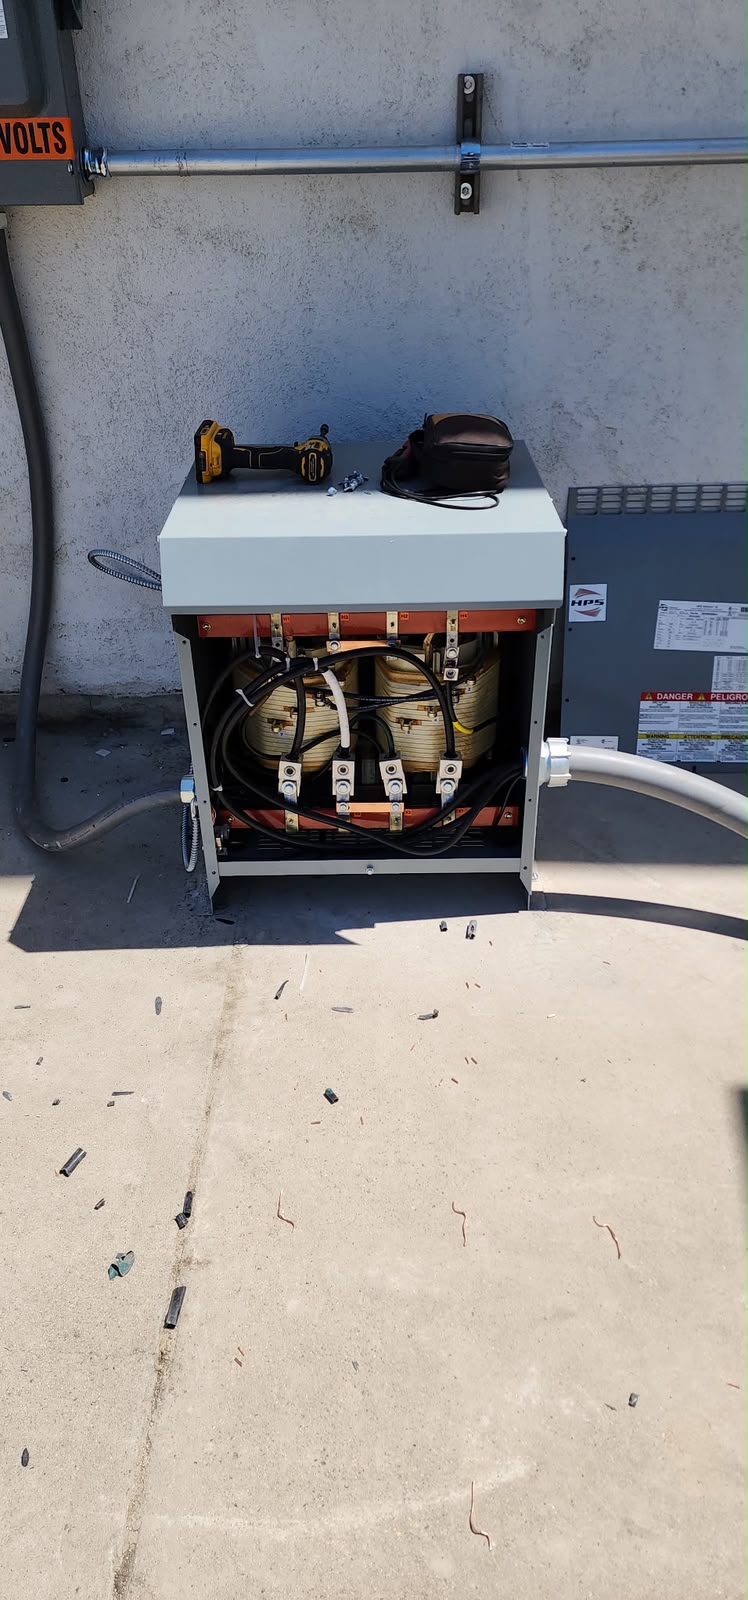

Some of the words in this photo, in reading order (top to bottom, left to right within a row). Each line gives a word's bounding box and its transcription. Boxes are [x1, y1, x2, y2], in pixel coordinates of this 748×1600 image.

[0, 121, 67, 155] VOLTS
[571, 598, 605, 606] HPS
[656, 693, 693, 701] DANGER
[710, 693, 748, 702] PELIGRO
